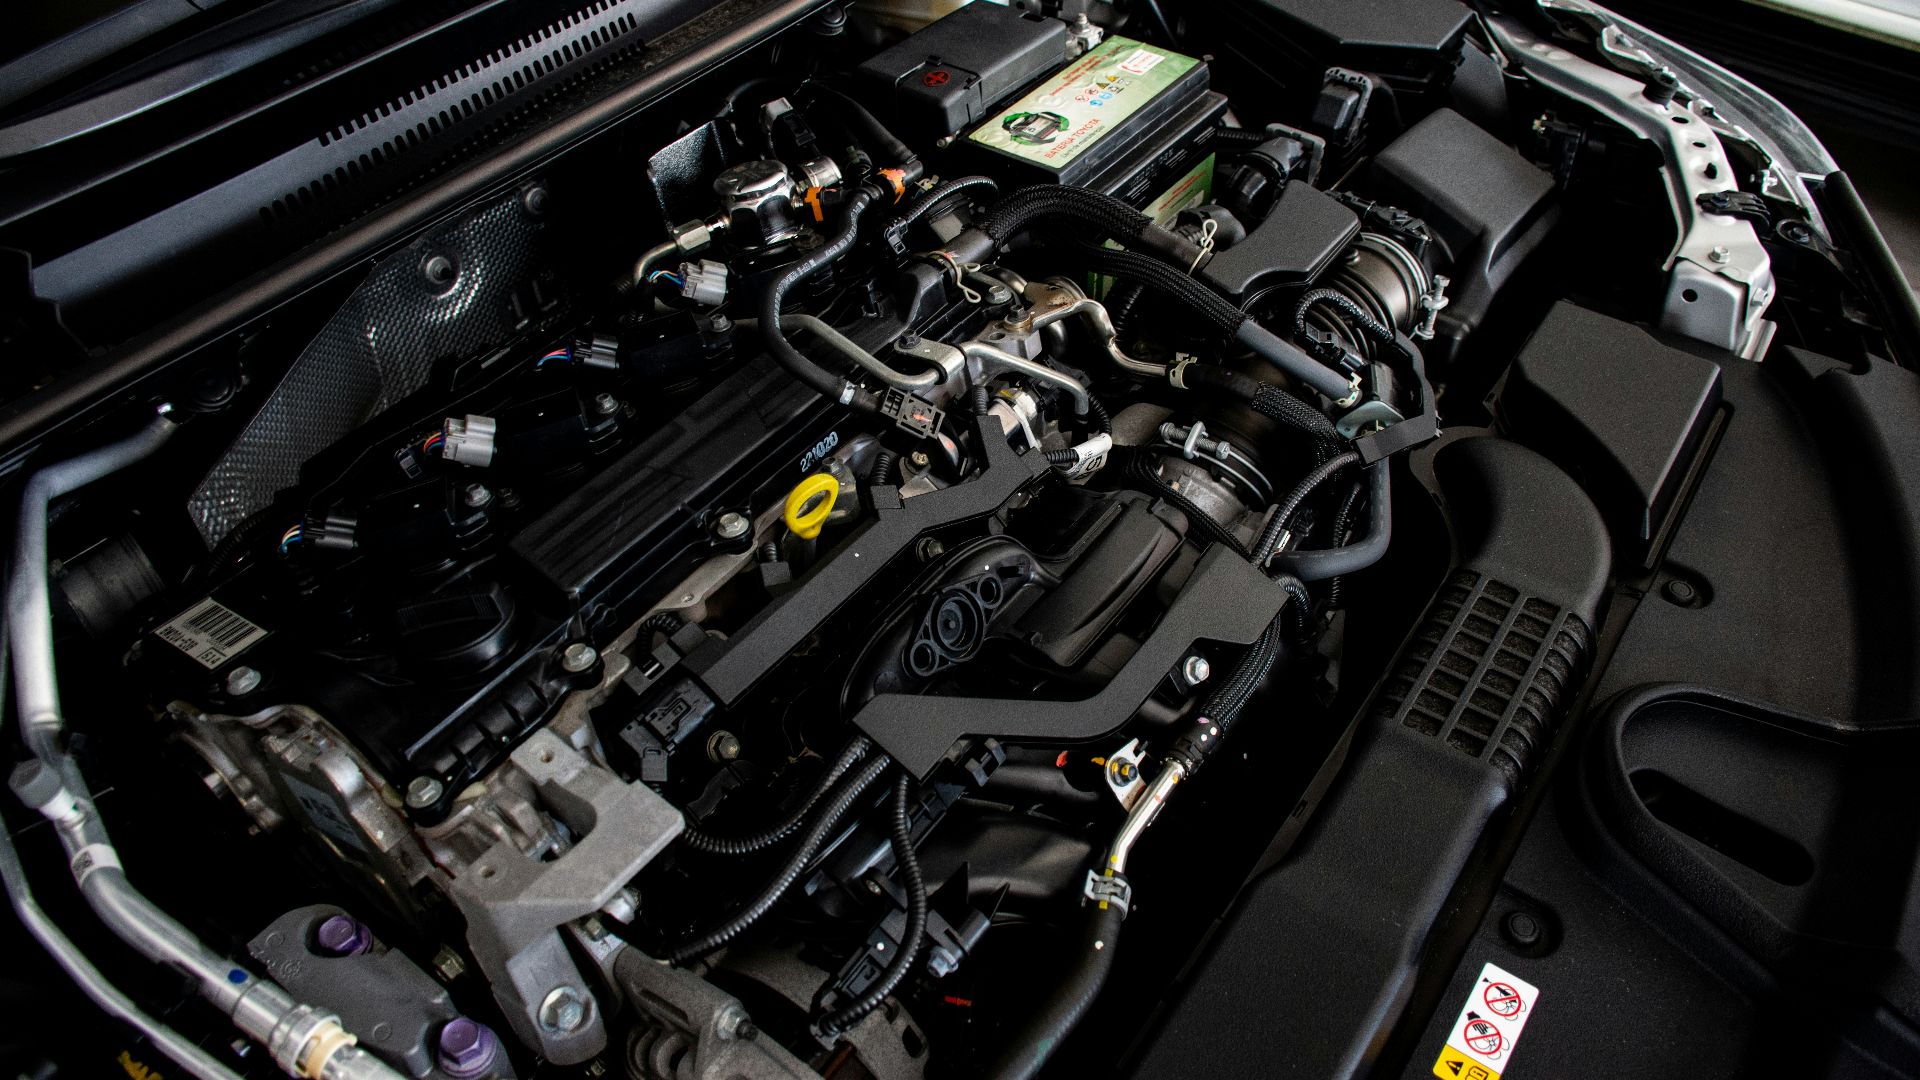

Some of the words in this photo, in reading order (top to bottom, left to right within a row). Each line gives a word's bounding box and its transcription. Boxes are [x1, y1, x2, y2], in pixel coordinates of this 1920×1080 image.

[1043, 137, 1074, 159] BATERIA
[1072, 119, 1100, 137] TOYOTA
[800, 431, 839, 473] 221020
